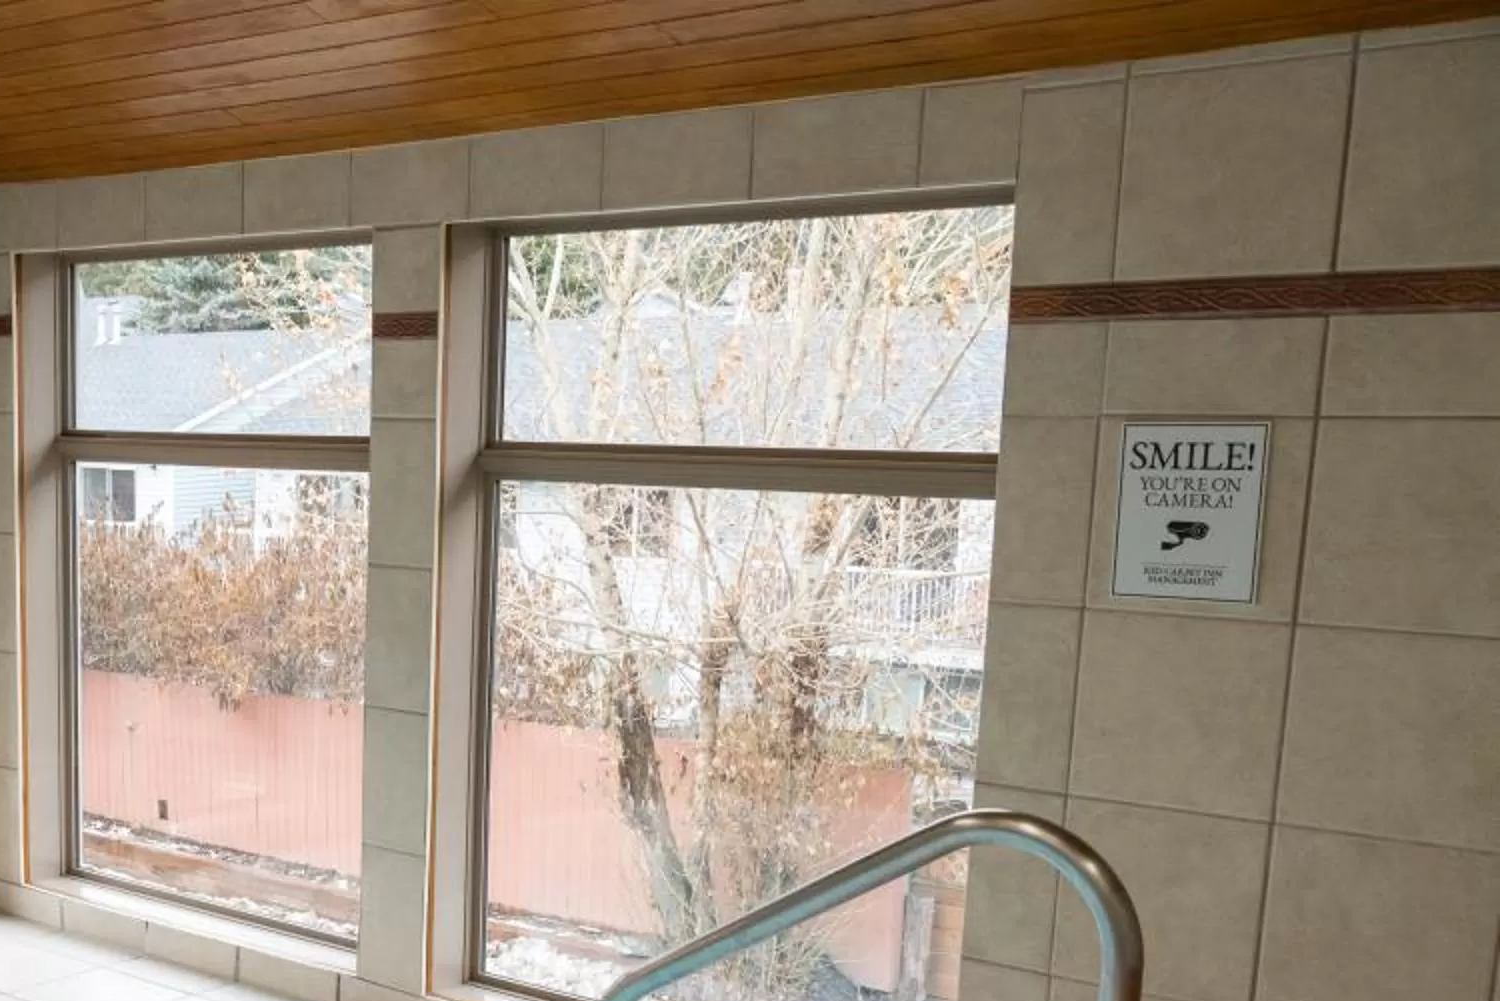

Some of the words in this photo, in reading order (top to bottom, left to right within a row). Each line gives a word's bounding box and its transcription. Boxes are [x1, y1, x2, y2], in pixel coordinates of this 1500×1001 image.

[1129, 441, 1256, 472] SMILE!
[1140, 475, 1208, 492] YOU'RE
[1211, 477, 1243, 493] ON
[1144, 492, 1234, 509] CAMERA!
